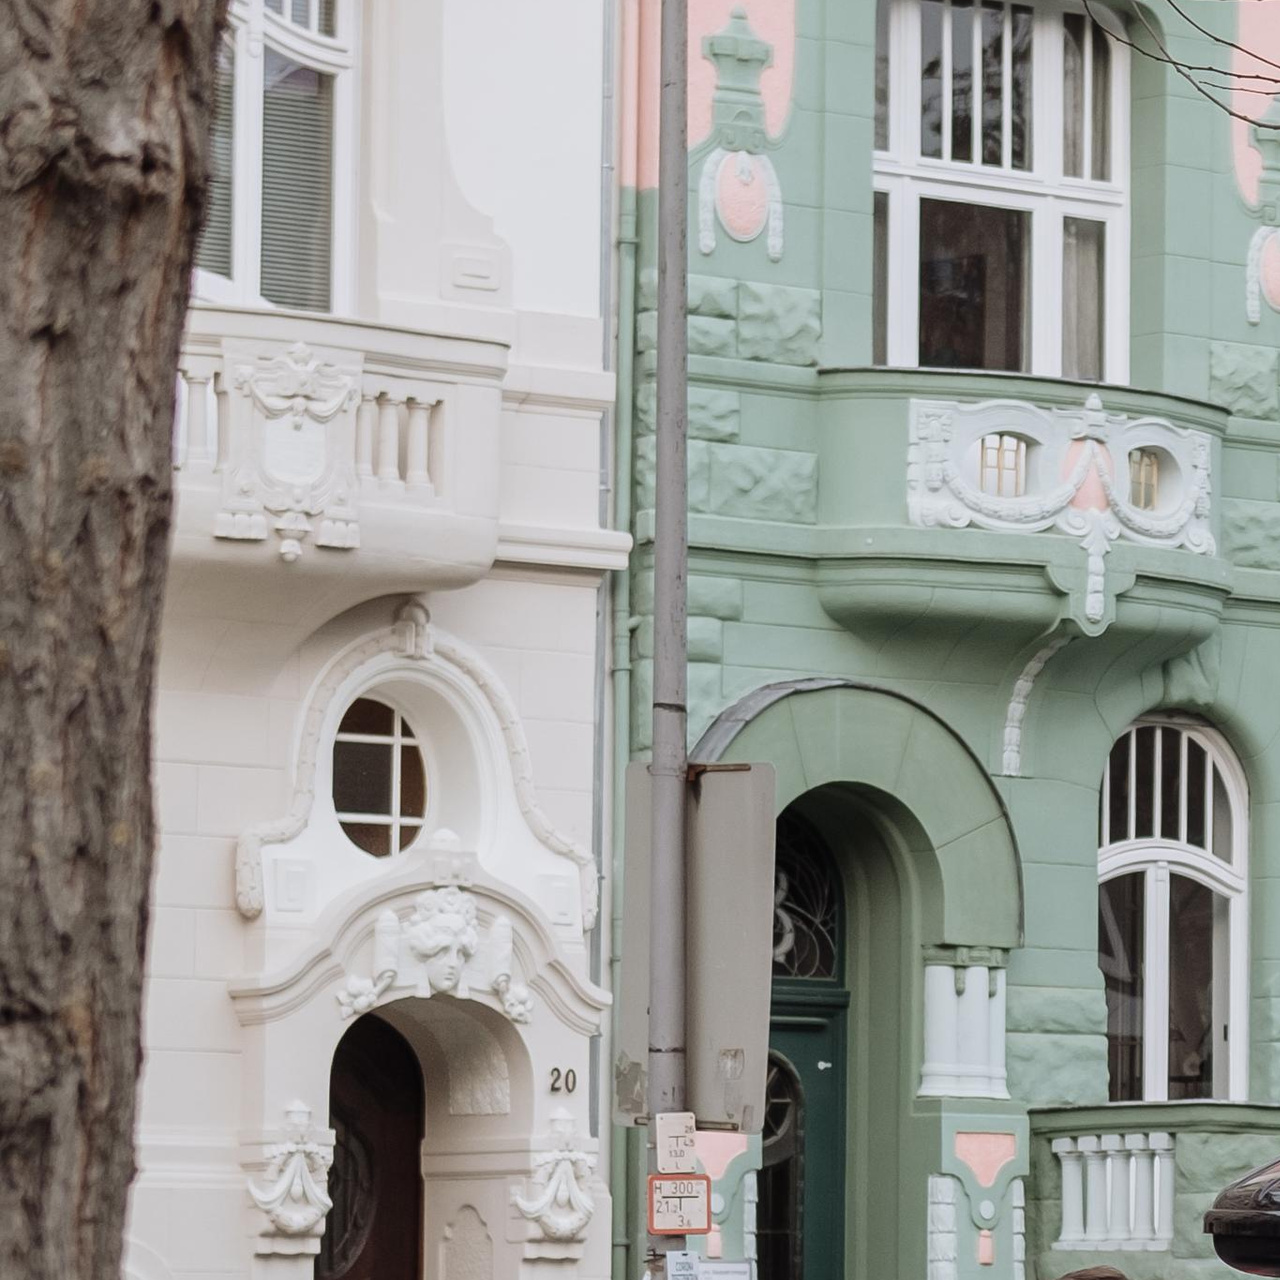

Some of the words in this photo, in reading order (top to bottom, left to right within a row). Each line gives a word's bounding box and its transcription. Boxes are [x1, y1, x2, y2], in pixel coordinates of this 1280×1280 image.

[551, 1067, 577, 1093] 20
[654, 1182, 662, 1195] H
[671, 1181, 693, 1195] 300
